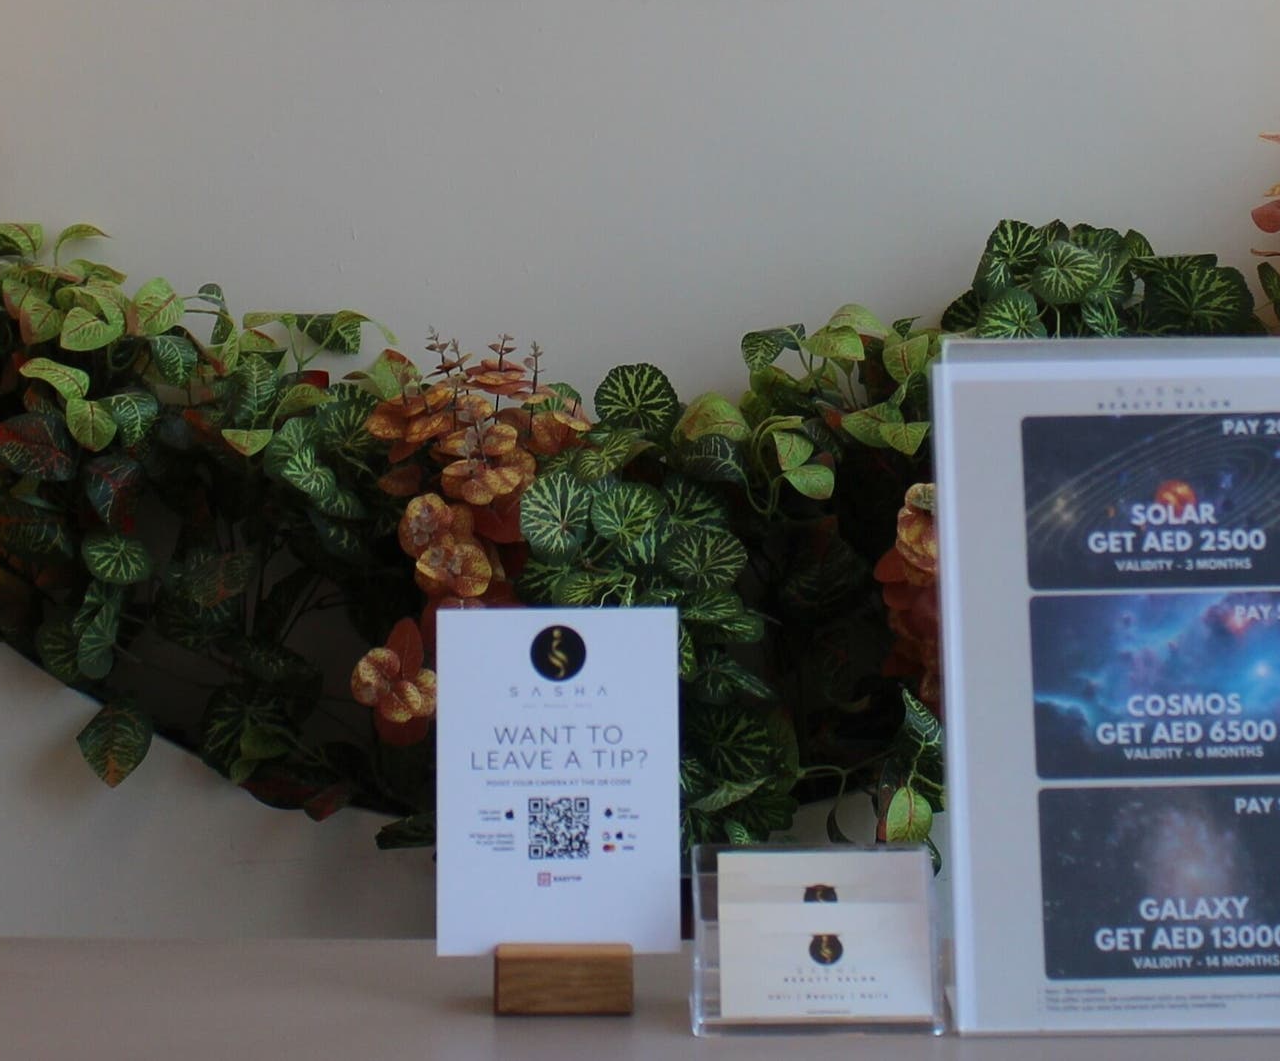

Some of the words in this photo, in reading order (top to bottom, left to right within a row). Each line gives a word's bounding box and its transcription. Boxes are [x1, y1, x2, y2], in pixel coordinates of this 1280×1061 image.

[1116, 385, 1205, 398] SASHA
[1097, 401, 1164, 410] BEAUTY
[1176, 400, 1232, 409] SALON
[1222, 419, 1260, 435] PAY
[1130, 502, 1217, 526] SOLAR
[1088, 532, 1136, 553] GET
[1141, 530, 1193, 553] AED
[1199, 529, 1266, 551] 2500
[1114, 559, 1173, 571] VALIDITY
[1185, 558, 1194, 571] 3
[1196, 557, 1253, 570] MONTHS
[1234, 604, 1272, 620] PAY
[508, 685, 608, 698] SASHA
[1126, 693, 1243, 717] COSMOS
[493, 725, 576, 745] WANT
[585, 724, 624, 745] TO
[1096, 722, 1146, 745] GET
[1151, 721, 1203, 744] AED
[1209, 720, 1277, 742] 6500
[470, 750, 553, 771] LEAVE
[564, 750, 582, 770] A
[590, 749, 649, 770] TIP?
[1123, 747, 1183, 760] VALIDITY
[1195, 746, 1204, 759] 6
[1205, 745, 1264, 758] MONTHS
[1234, 797, 1274, 814] PAY
[1139, 896, 1250, 921] GALAXY
[1095, 928, 1146, 951] GET
[1151, 927, 1205, 950] AED
[1132, 956, 1194, 969] VALIDITY
[1205, 955, 1221, 968] 14
[1222, 954, 1280, 968] MONTHS
